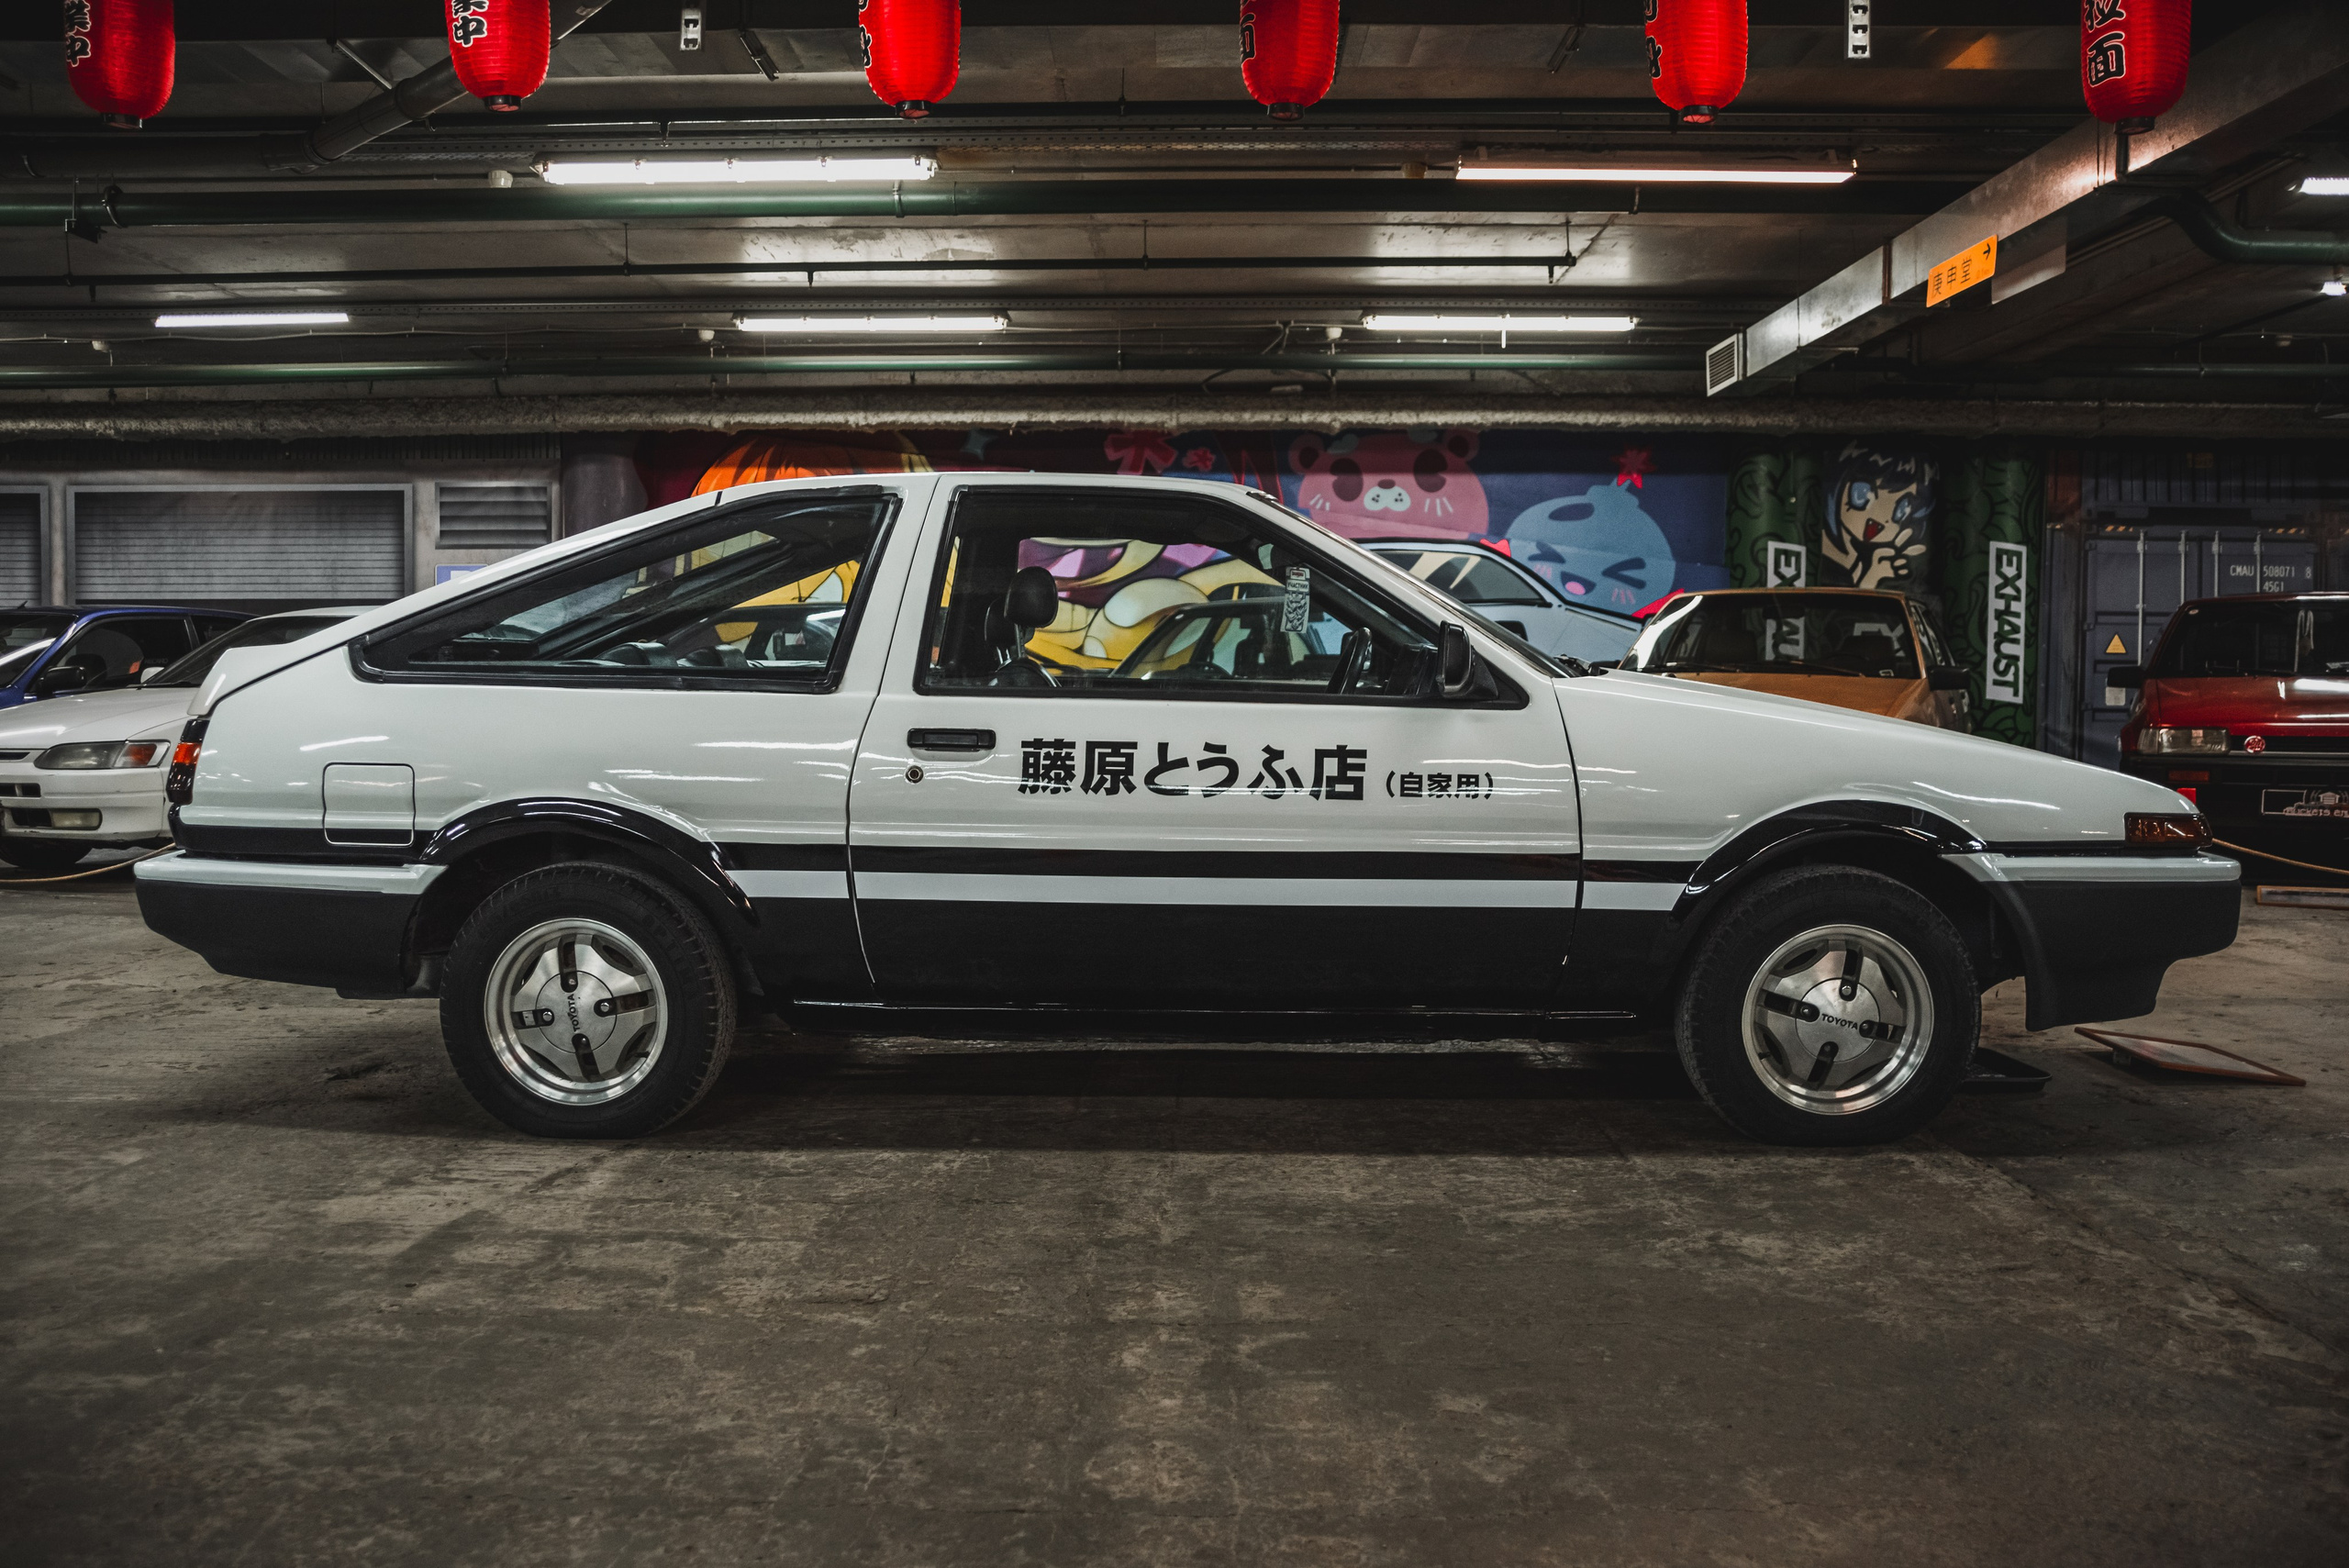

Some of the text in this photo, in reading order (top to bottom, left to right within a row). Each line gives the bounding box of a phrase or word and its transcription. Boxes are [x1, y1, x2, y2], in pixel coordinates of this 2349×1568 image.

[1932, 254, 1973, 299] 庚申堂
[2230, 564, 2254, 577] CMAU
[2263, 565, 2296, 578] 508071
[2263, 581, 2285, 593] 45G1
[1992, 547, 2023, 697] EXHAUST
[1017, 738, 1367, 801] 藤原とうふ店
[567, 994, 580, 1032] TOYOTA
[1820, 1013, 1858, 1030] TOYOTA
